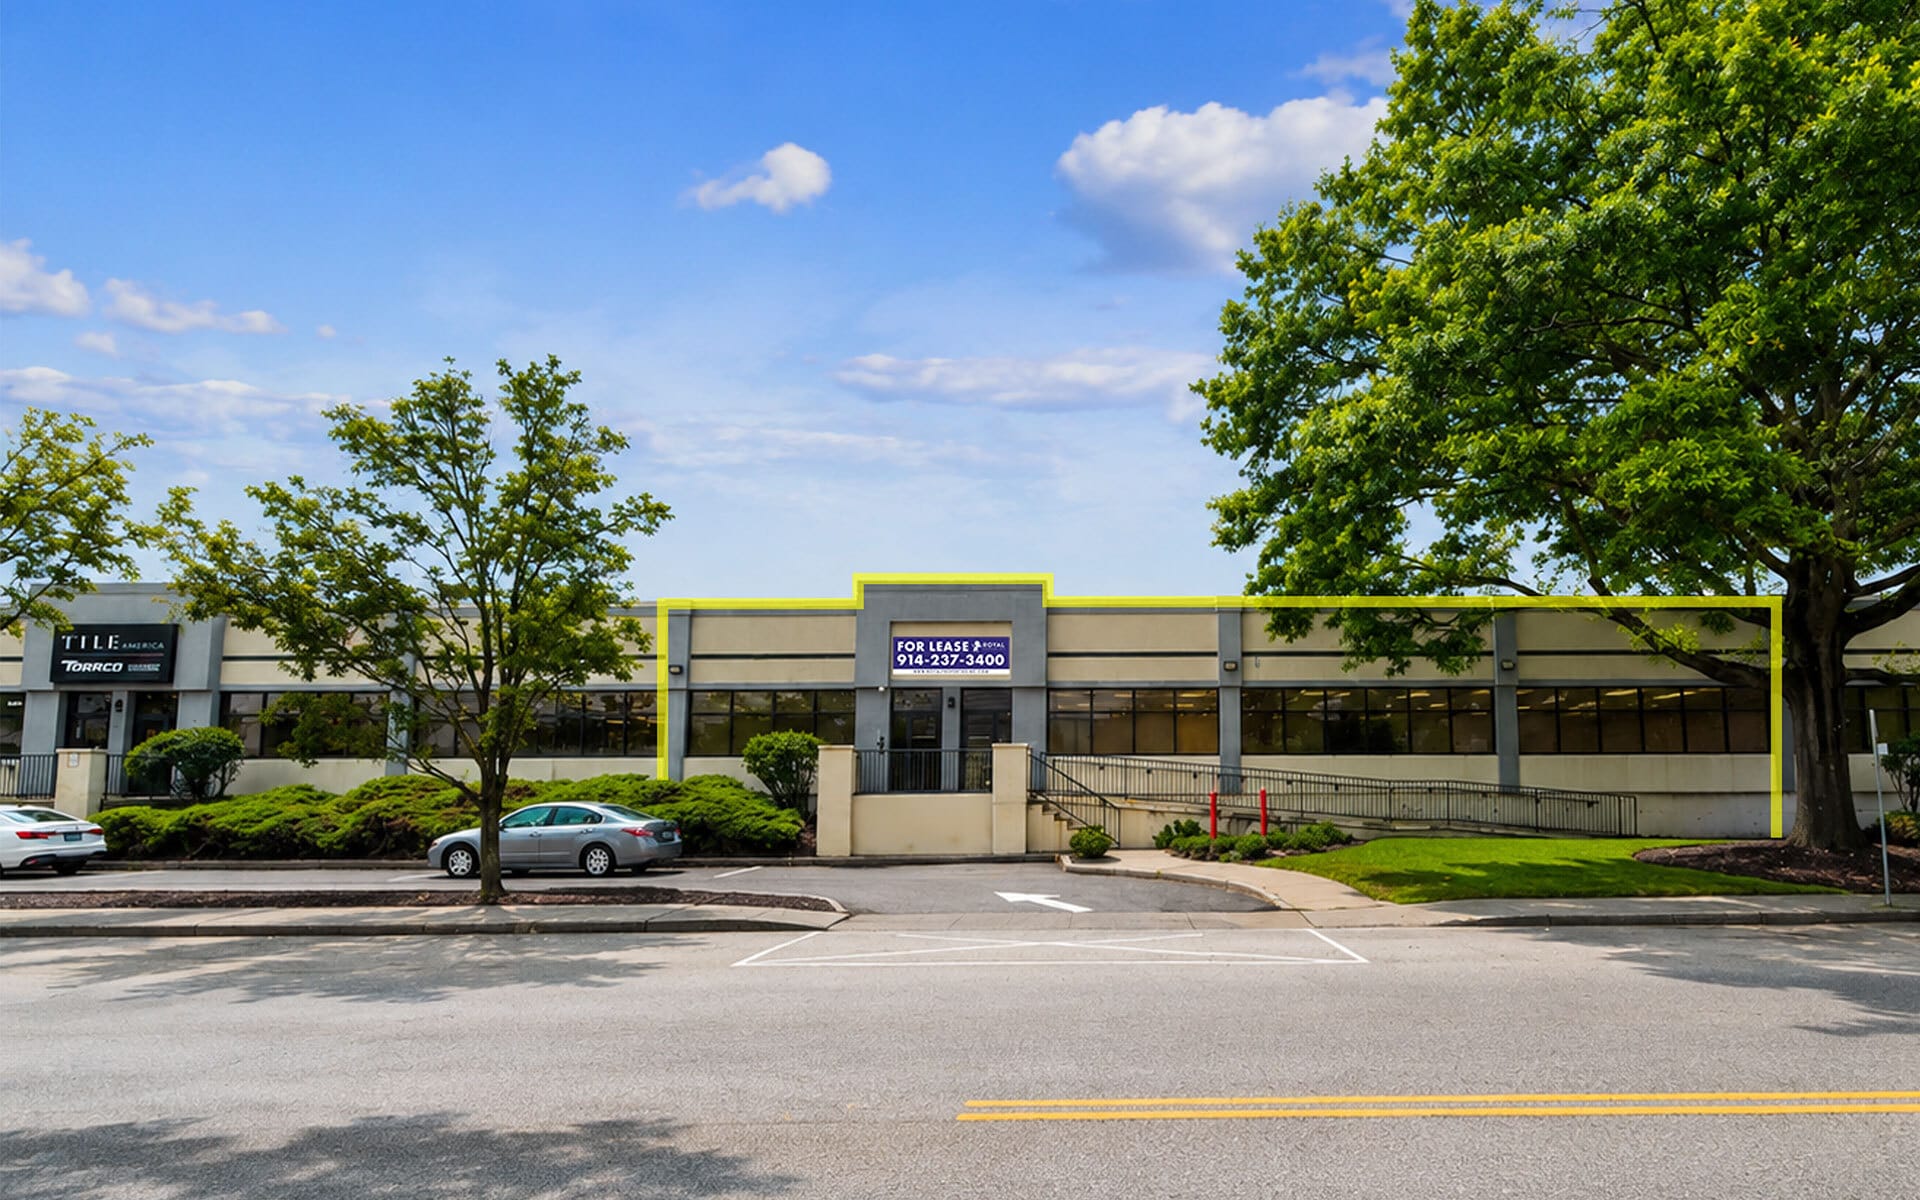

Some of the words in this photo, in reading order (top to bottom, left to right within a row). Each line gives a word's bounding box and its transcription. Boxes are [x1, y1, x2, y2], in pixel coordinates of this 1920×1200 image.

[61, 635, 120, 649] TILE
[897, 641, 925, 652] FOR
[929, 641, 969, 652] LEASE
[897, 654, 1005, 666] 914-237-3400
